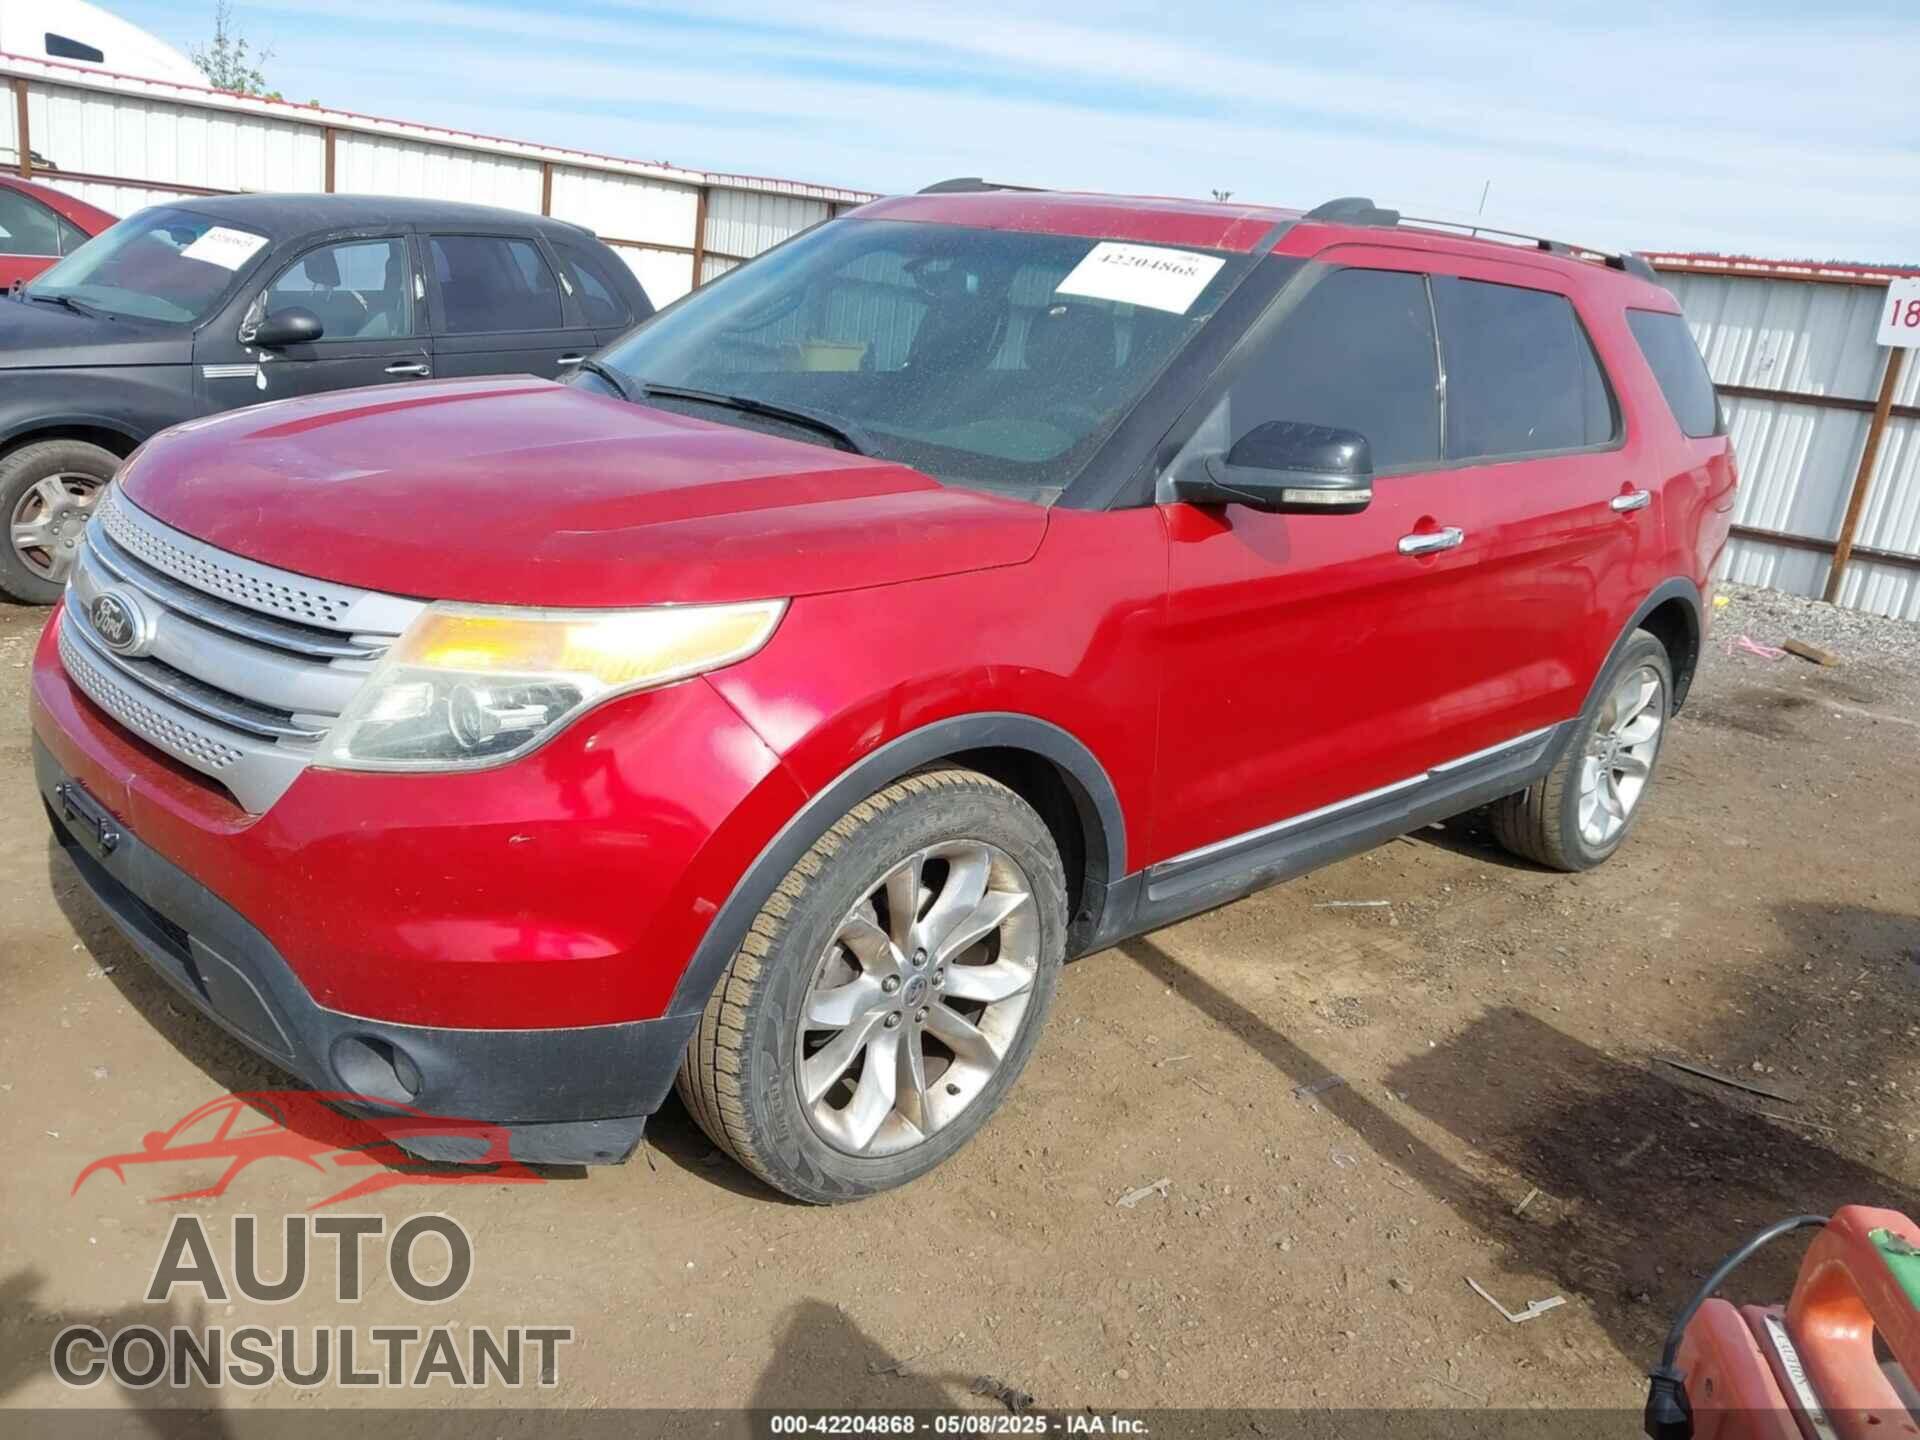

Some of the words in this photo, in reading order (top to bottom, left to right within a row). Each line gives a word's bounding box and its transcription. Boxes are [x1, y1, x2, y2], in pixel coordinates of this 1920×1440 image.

[1099, 253, 1199, 277] 42204868
[1890, 298, 1920, 328] 18
[95, 598, 126, 641] Ford
